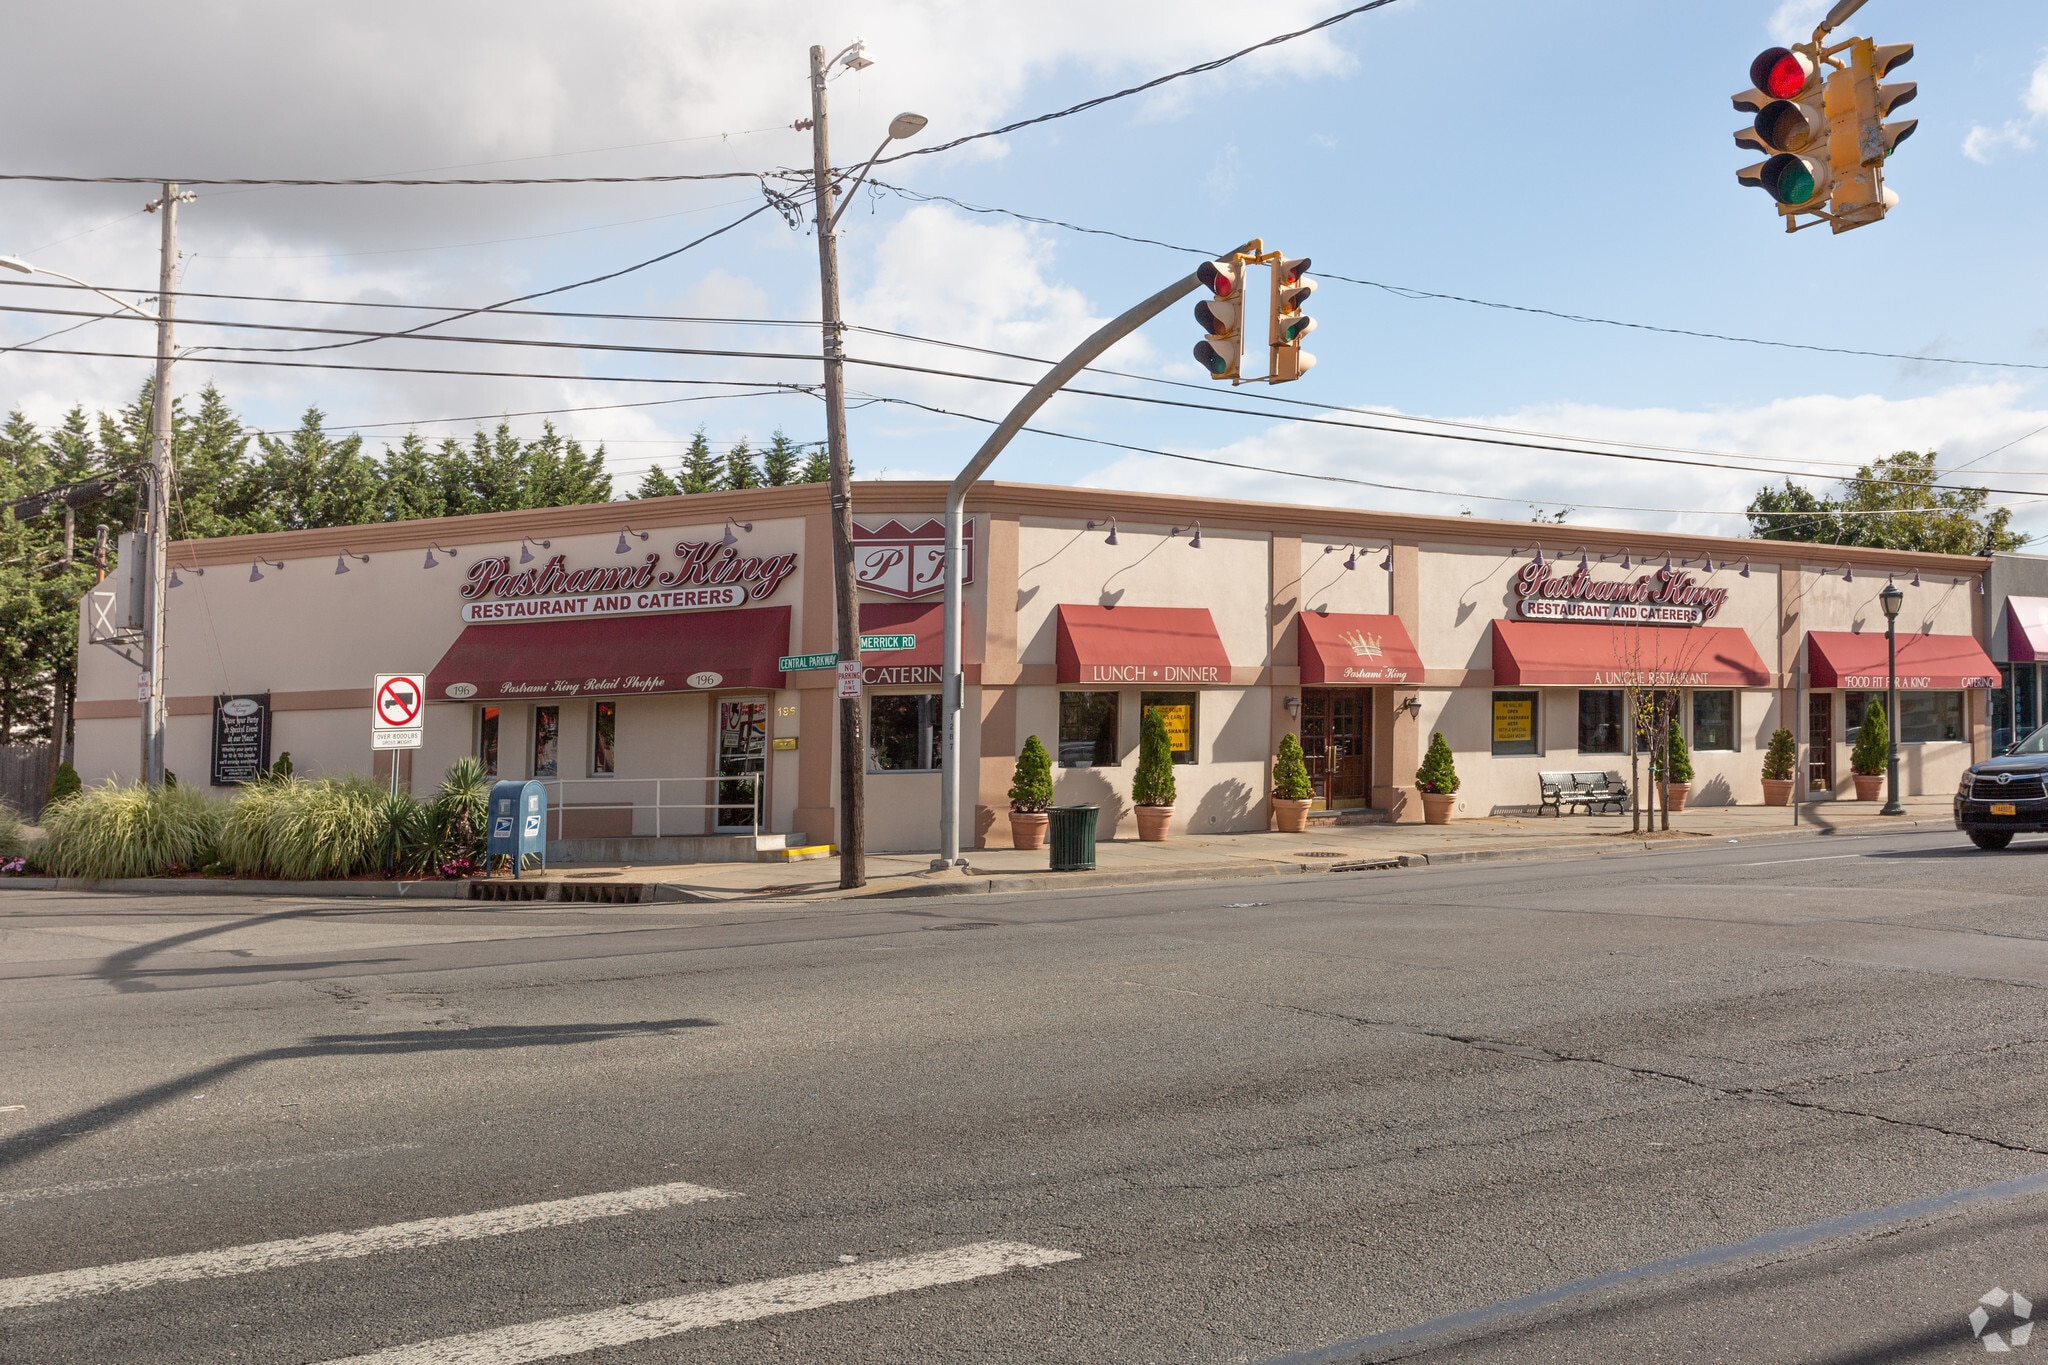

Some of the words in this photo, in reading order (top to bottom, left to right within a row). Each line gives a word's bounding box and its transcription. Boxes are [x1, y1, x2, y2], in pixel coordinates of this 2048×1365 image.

[459, 553, 660, 599] Pastrami
[658, 540, 798, 600] King
[859, 548, 904, 581] P
[1514, 562, 1651, 602] Pastrami
[1651, 569, 1729, 620] King
[471, 598, 588, 619] RESTAURANT
[593, 595, 632, 612] AND
[637, 588, 733, 609] CATERERS
[1527, 602, 1609, 618] RESTAURANT
[1613, 605, 1637, 619] AND
[1640, 606, 1698, 621] CATERERS
[861, 636, 899, 648] MERRICK
[902, 636, 914, 647] RD
[781, 657, 808, 669] CENTRAL
[809, 654, 837, 667] PARKWAY
[695, 674, 714, 685] 196
[840, 672, 860, 680] PARKING
[862, 666, 943, 684] CATERIN
[1093, 665, 1146, 681] LUNCH
[1164, 666, 1218, 681] DINNER
[1343, 667, 1383, 678] Pastrami
[1384, 667, 1408, 683] King
[1594, 671, 1602, 684] A
[1605, 671, 1644, 684] UNIQUE
[1648, 671, 1708, 685] RESTAURANT
[453, 685, 470, 695] 196
[500, 681, 549, 694] Pastrami
[551, 679, 580, 696] King
[583, 676, 621, 690] Retail
[622, 675, 665, 691] Shoppe
[1872, 676, 1883, 688] FIT
[1886, 676, 1900, 688] FR
[1903, 677, 1909, 688] A
[1961, 676, 1994, 688] CATERING
